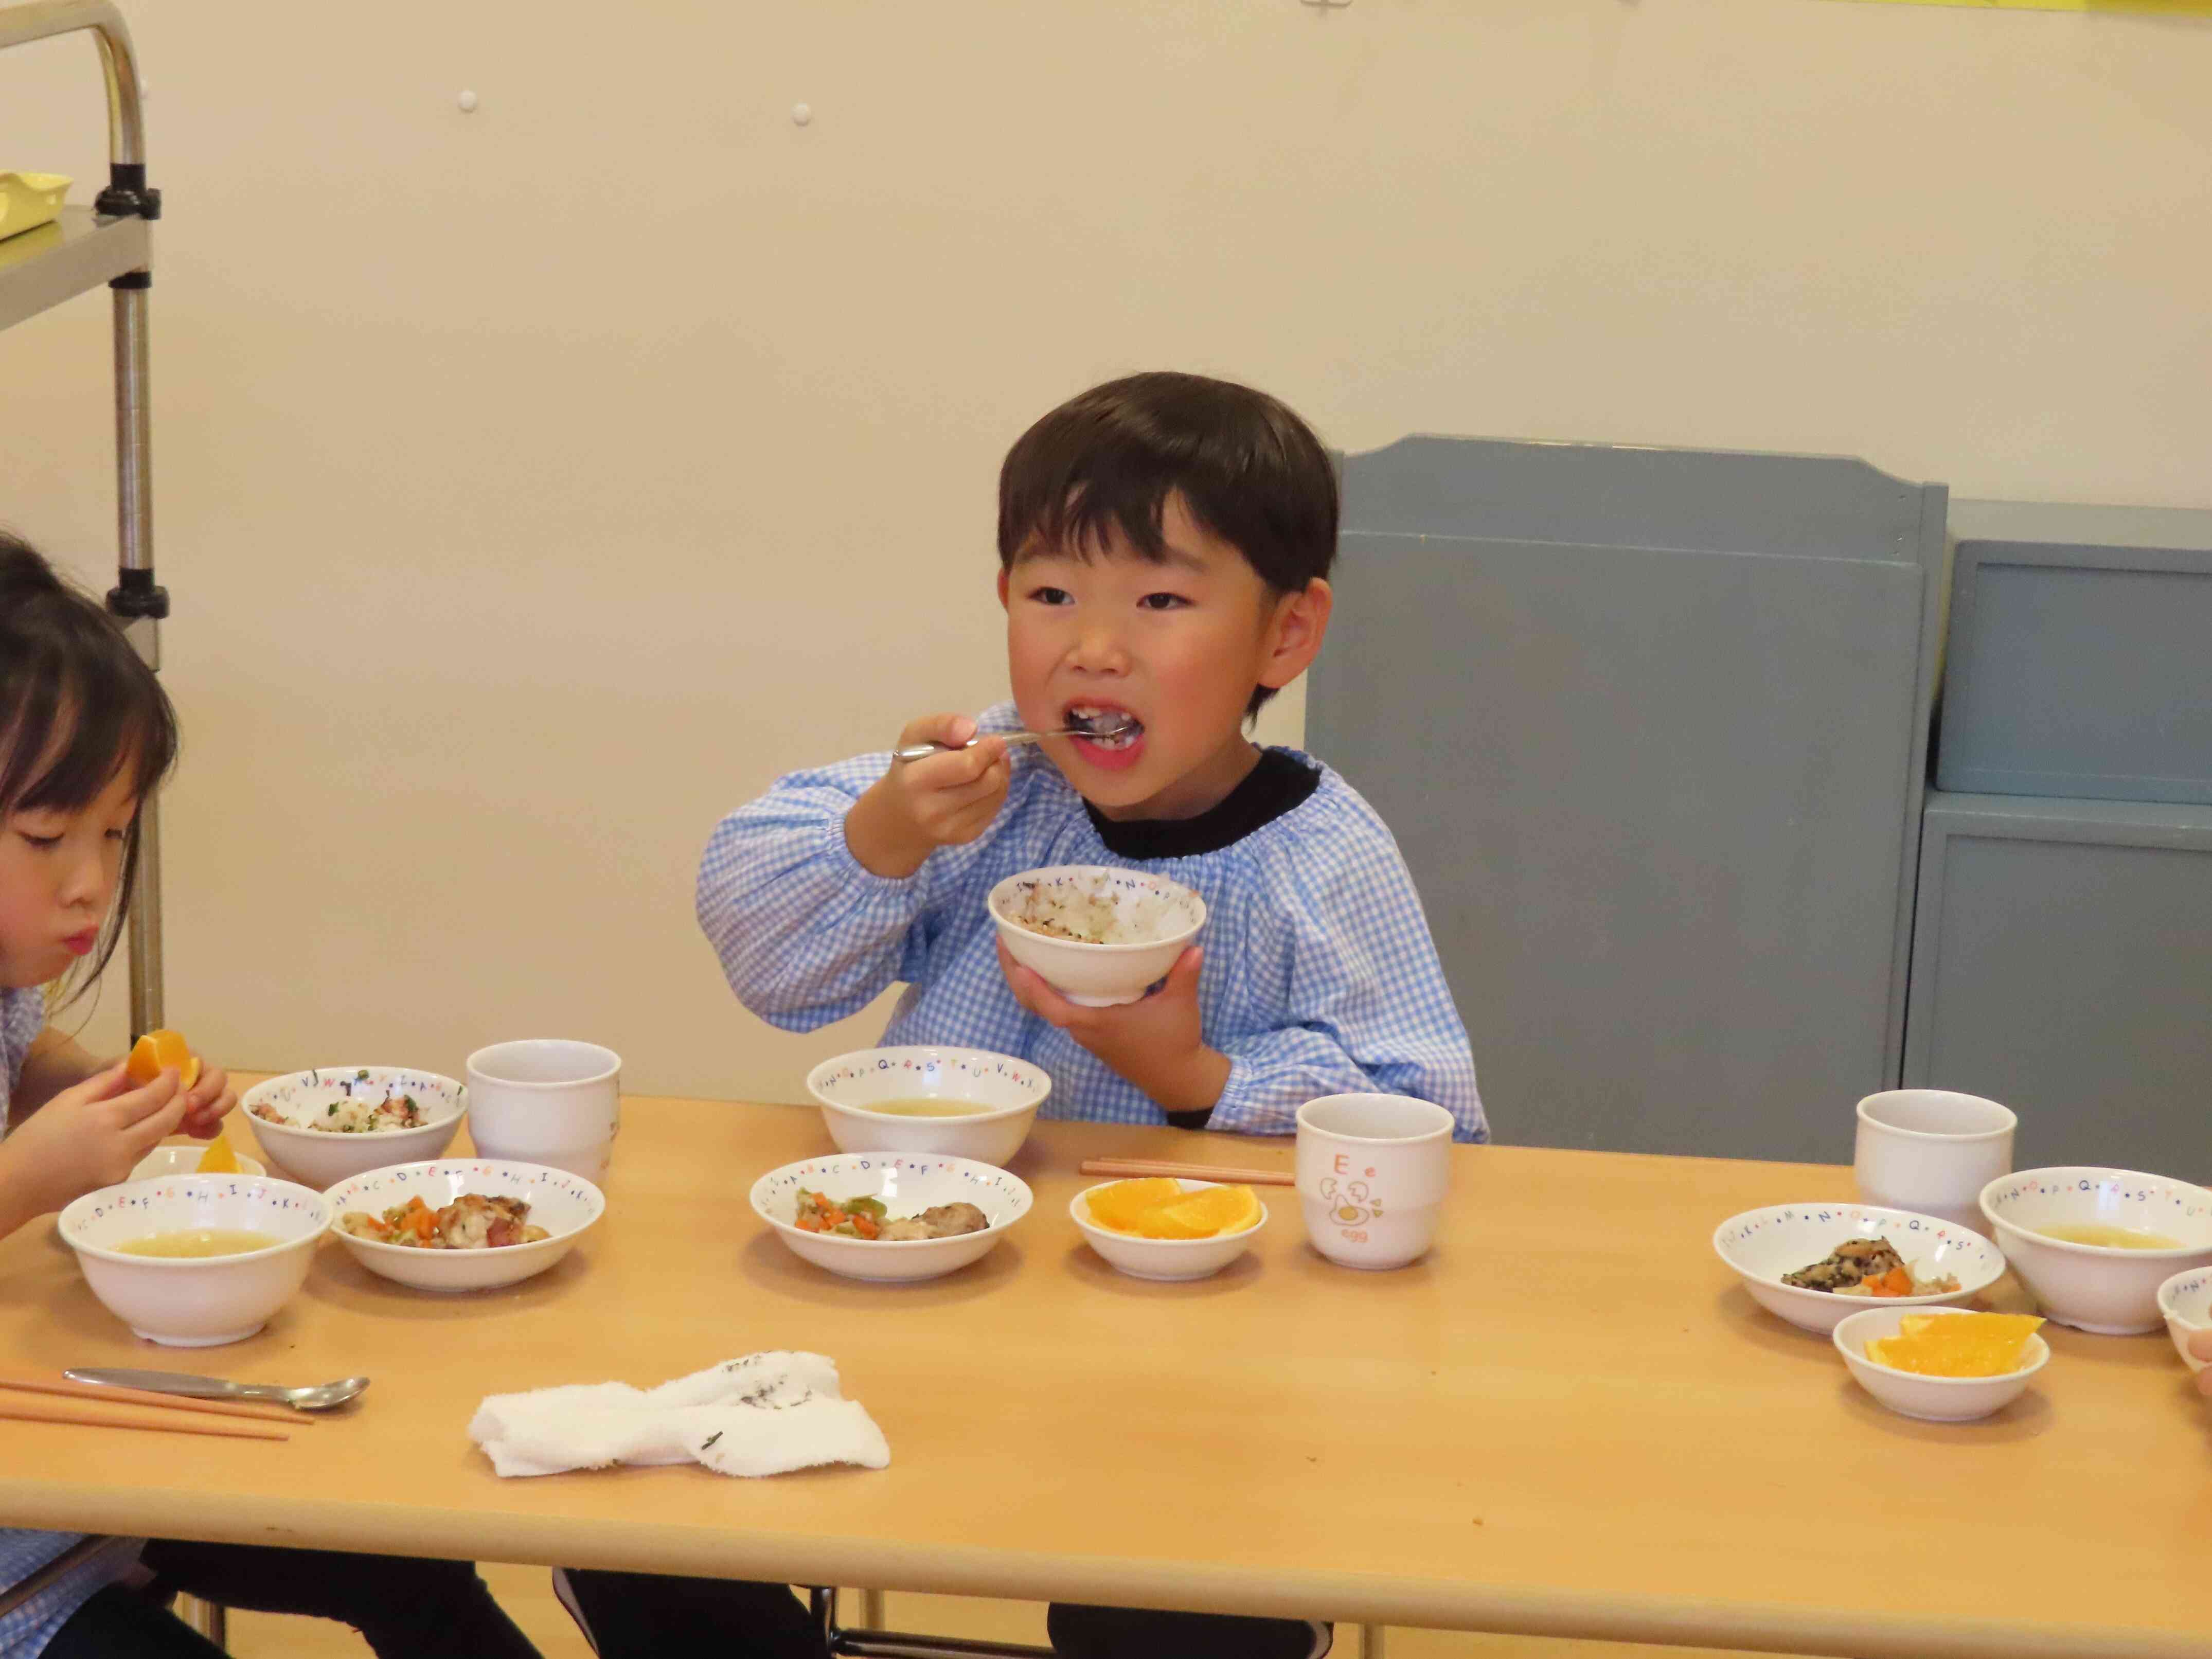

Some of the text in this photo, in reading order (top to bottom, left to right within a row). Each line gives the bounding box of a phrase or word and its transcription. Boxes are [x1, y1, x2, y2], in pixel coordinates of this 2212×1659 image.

[1126, 879, 1135, 890] N
[878, 1060, 889, 1069] Q
[926, 1062, 935, 1072] S
[973, 1068, 981, 1077] U
[997, 1062, 1004, 1073] V
[397, 1172, 407, 1181] D
[429, 1167, 436, 1176] E
[541, 1173, 548, 1182] I
[790, 1176, 797, 1184] A
[833, 1165, 840, 1173] C
[861, 1161, 870, 1170] D
[921, 1165, 927, 1175] F
[1334, 1154, 1350, 1175] E
[95, 1208, 103, 1217] D
[119, 1197, 125, 1208] E
[142, 1198, 149, 1209] F
[229, 1184, 237, 1195] I
[2079, 1180, 2091, 1190] Q
[2138, 1191, 2146, 1201] S
[1341, 1229, 1368, 1243] egg
[1818, 1210, 1831, 1222] N
[1909, 1220, 1919, 1230] Q
[1956, 1241, 1964, 1250] S
